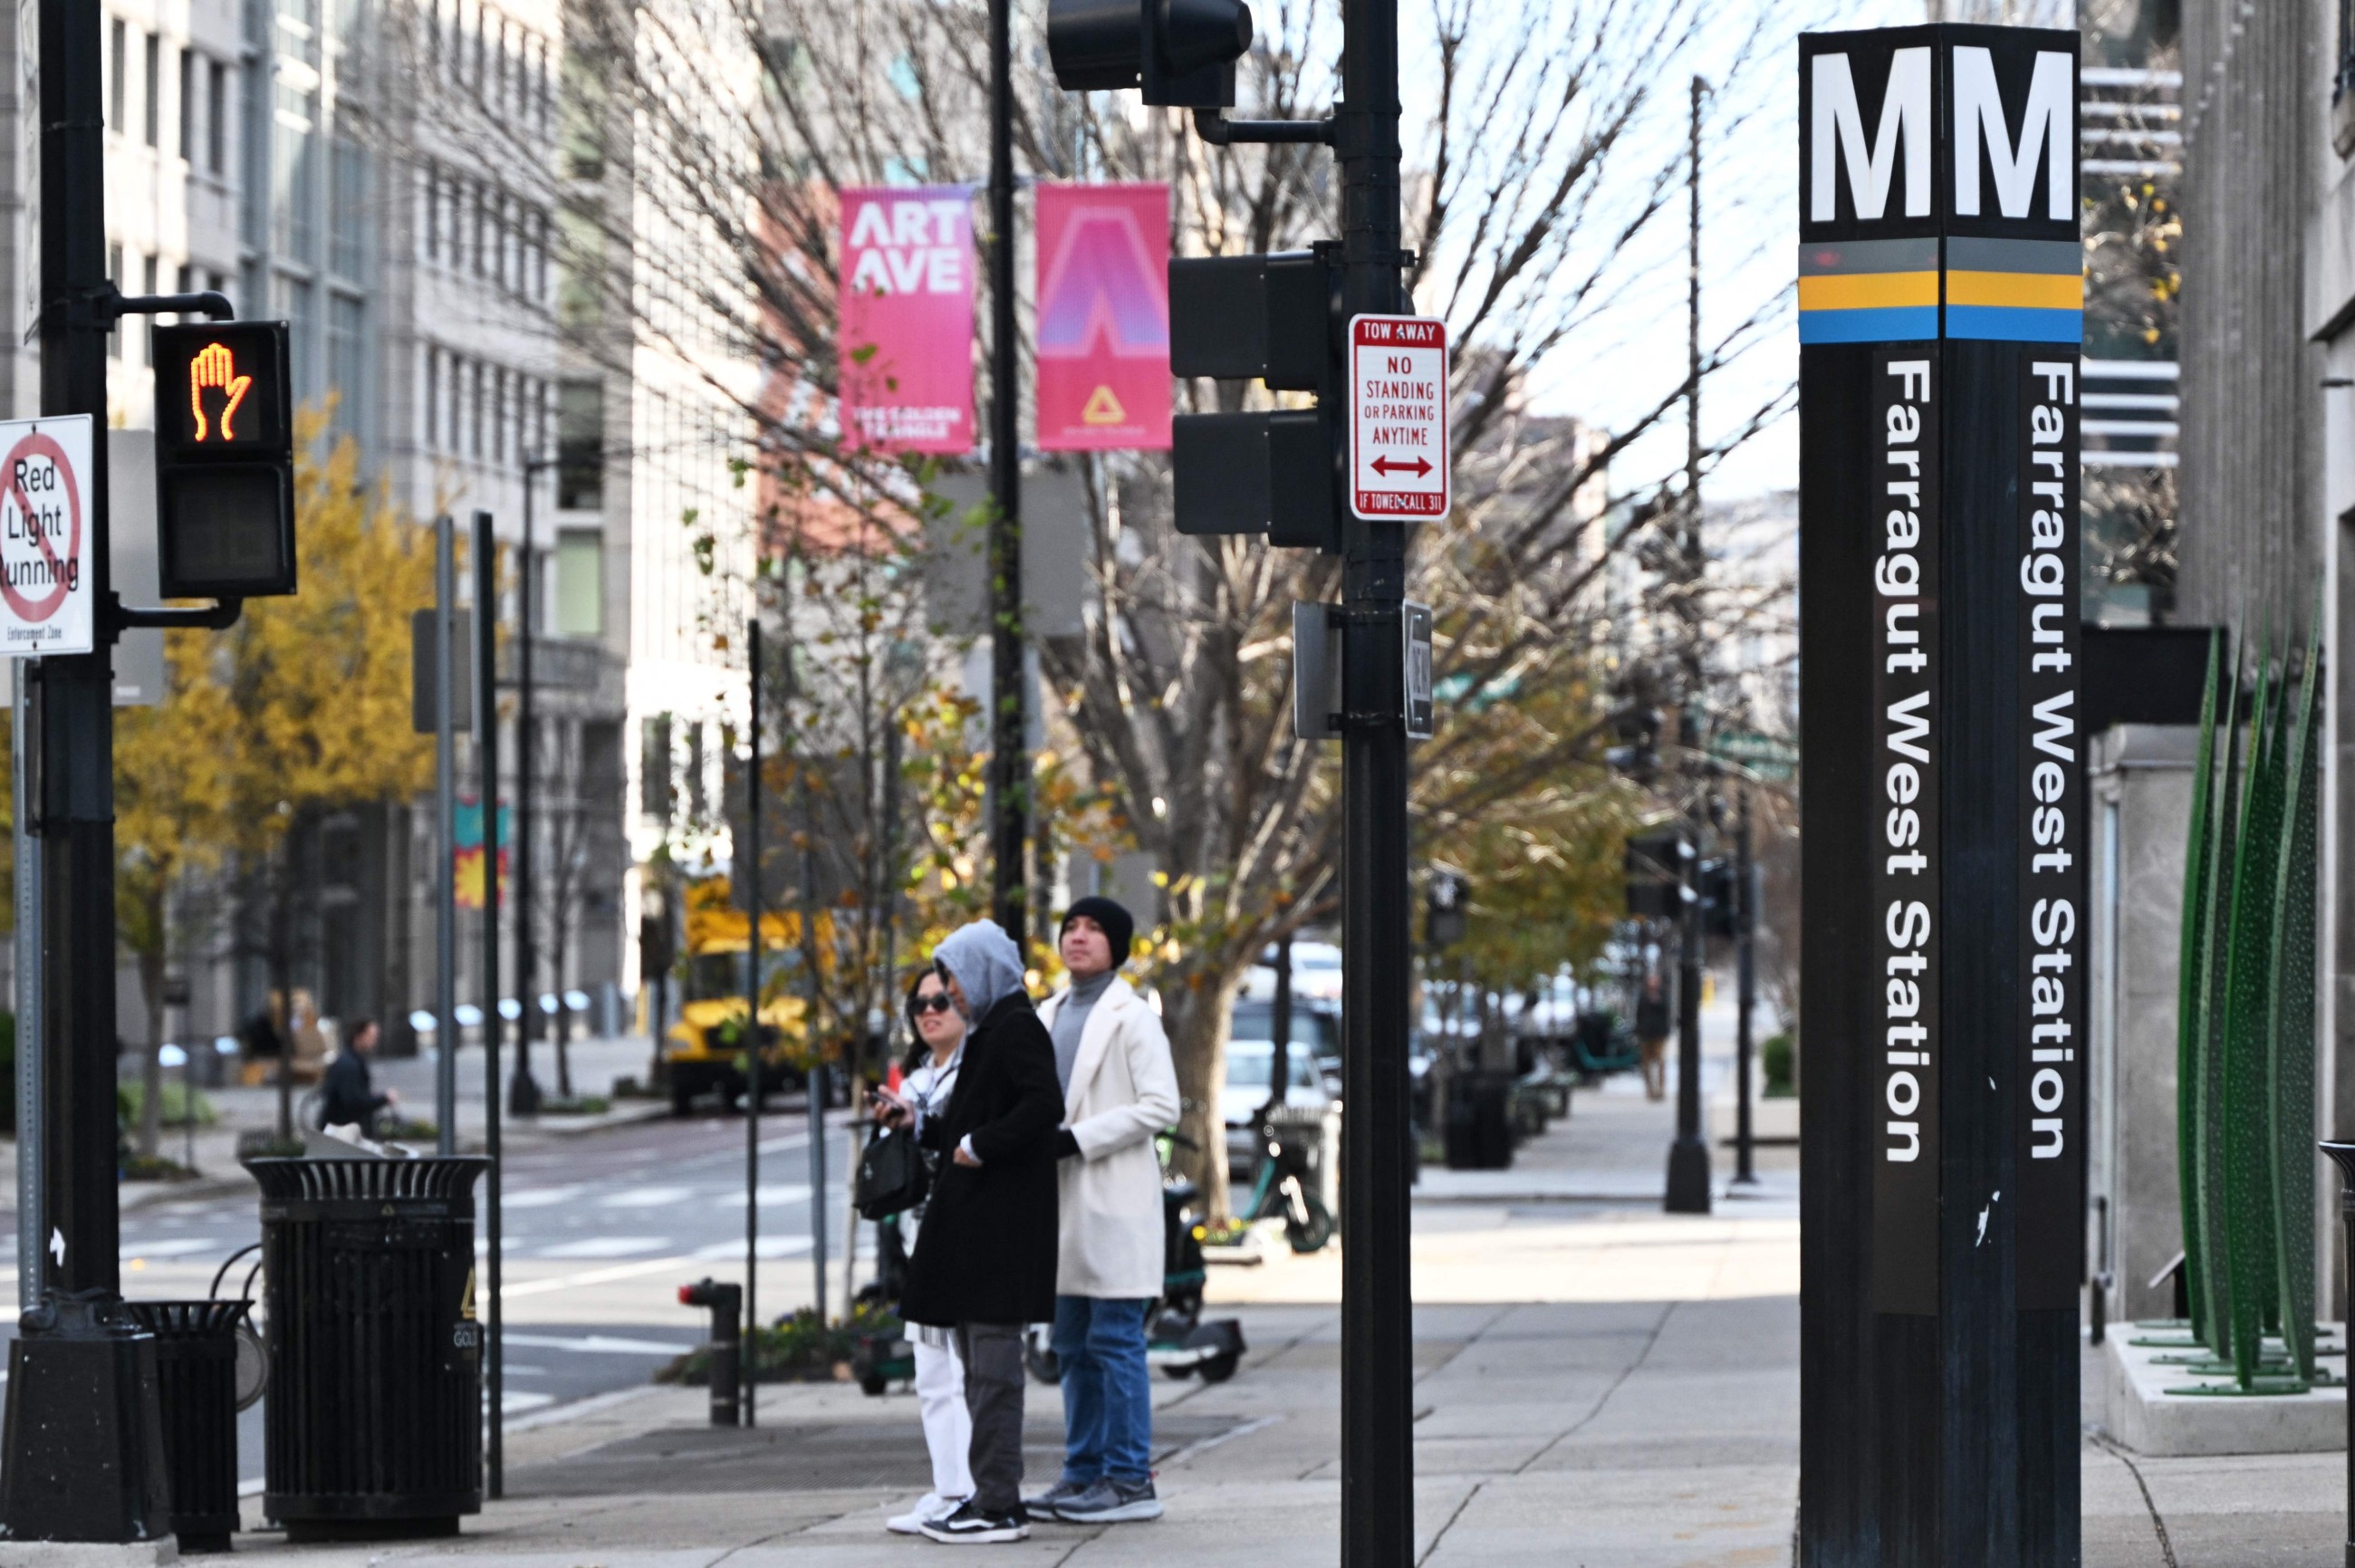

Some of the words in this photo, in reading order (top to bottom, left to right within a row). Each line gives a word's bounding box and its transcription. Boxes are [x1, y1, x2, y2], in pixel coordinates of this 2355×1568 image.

[1811, 46, 1932, 222] M
[1953, 45, 2074, 221] M
[850, 200, 965, 246] ART
[851, 247, 963, 294] AVE
[1363, 322, 1391, 339] TOW
[1396, 323, 1436, 341] AWAY
[1388, 356, 1412, 374] NO
[1364, 405, 1379, 418] OR
[1382, 404, 1435, 421] PARKING
[1366, 380, 1434, 400] STANDING
[1372, 427, 1428, 446] ANYTIME
[14, 457, 55, 494] Red
[7, 503, 62, 547] Light
[1360, 493, 1369, 508] IF
[1403, 495, 1426, 510] CALL
[1428, 495, 1442, 511] 311
[1875, 360, 1930, 674] Farragut
[2021, 361, 2073, 673] Farragut
[1885, 690, 1930, 876] West
[2031, 690, 2074, 874] West
[1886, 900, 1931, 1162] Station
[2031, 899, 2075, 1159] Station
